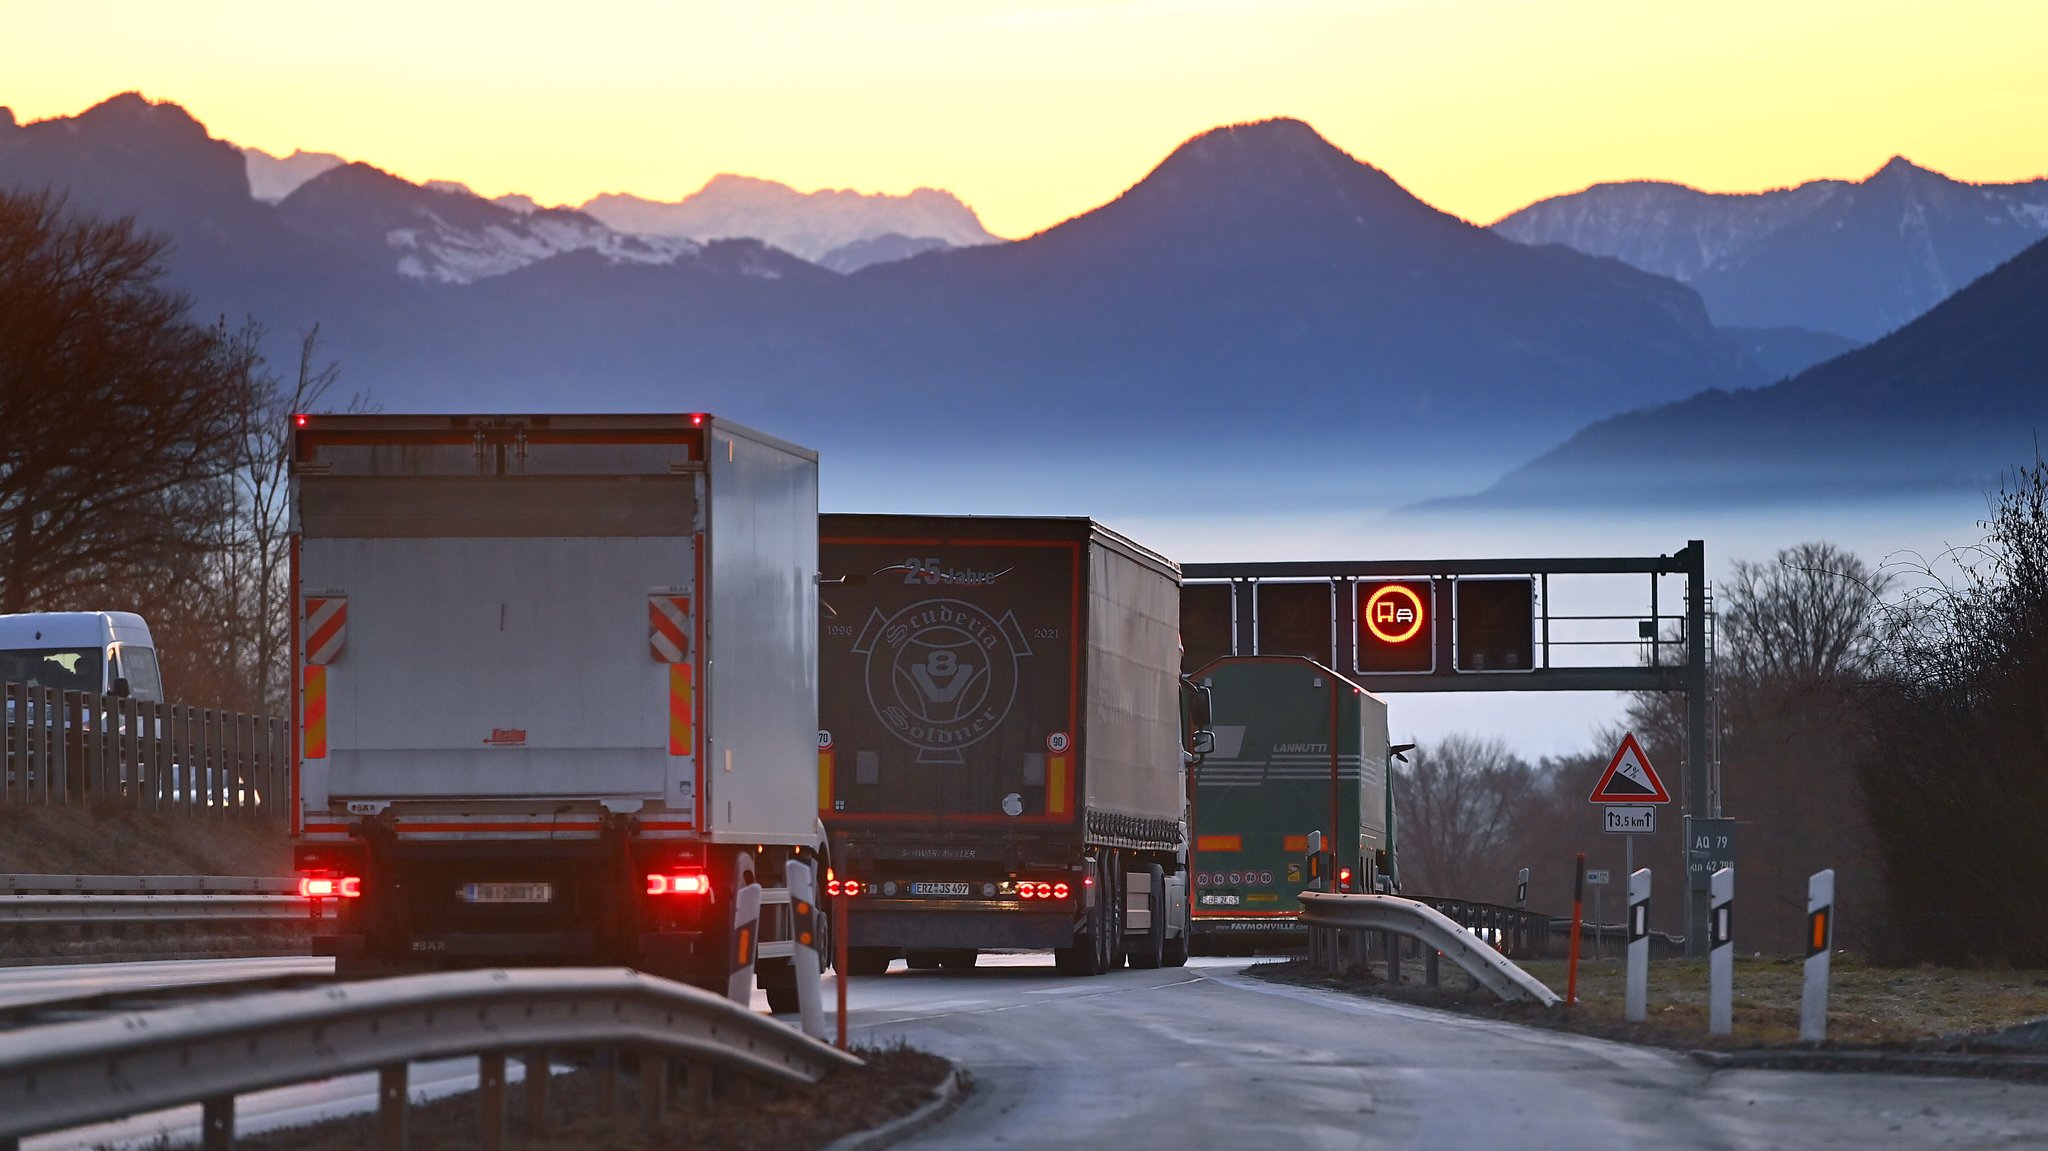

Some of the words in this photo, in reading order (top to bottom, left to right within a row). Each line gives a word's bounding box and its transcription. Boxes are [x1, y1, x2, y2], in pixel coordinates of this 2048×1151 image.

[904, 557, 941, 585] 25
[944, 568, 995, 585] Jahre
[886, 604, 999, 650] Scuderia
[1034, 628, 1059, 639] 2021
[818, 733, 829, 743] 70
[1053, 736, 1063, 747] 90
[1272, 743, 1328, 753] LANNUTTI
[1623, 762, 1640, 779] 7%
[1631, 816, 1645, 827] km
[1695, 836, 1710, 849] AQ
[1716, 836, 1728, 849] 79
[952, 884, 968, 893] 497
